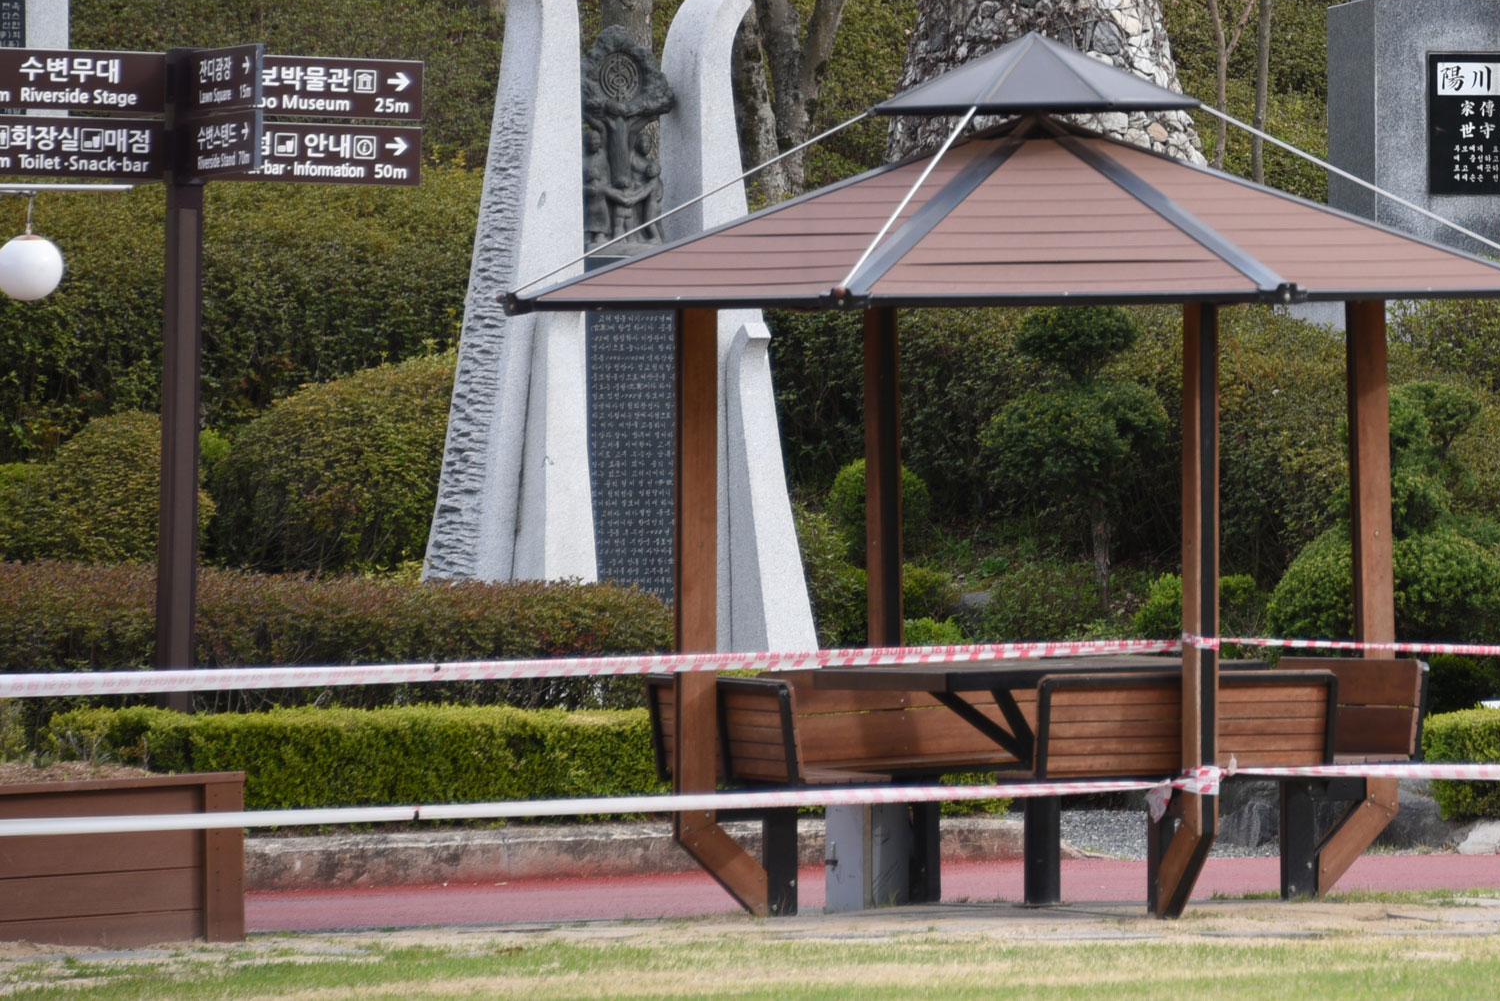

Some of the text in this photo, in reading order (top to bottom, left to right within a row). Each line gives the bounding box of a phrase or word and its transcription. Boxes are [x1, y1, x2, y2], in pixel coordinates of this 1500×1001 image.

[19, 56, 121, 84] 수변무대
[199, 55, 232, 84] 잔디광장
[261, 65, 351, 93] 보박물관
[20, 87, 89, 104] Riverside
[93, 89, 137, 107] Stage
[199, 89, 213, 104] Lawn
[213, 87, 232, 104] Square
[239, 83, 252, 99] 15m
[282, 95, 350, 112] Museum
[374, 98, 409, 114] 25m
[10, 125, 151, 153] 화장실 매점
[304, 133, 351, 158] 안내
[18, 154, 61, 169] Toilet
[197, 150, 250, 170] Riverside Stand 70m
[293, 162, 365, 178] Information
[374, 163, 408, 179] 50m
